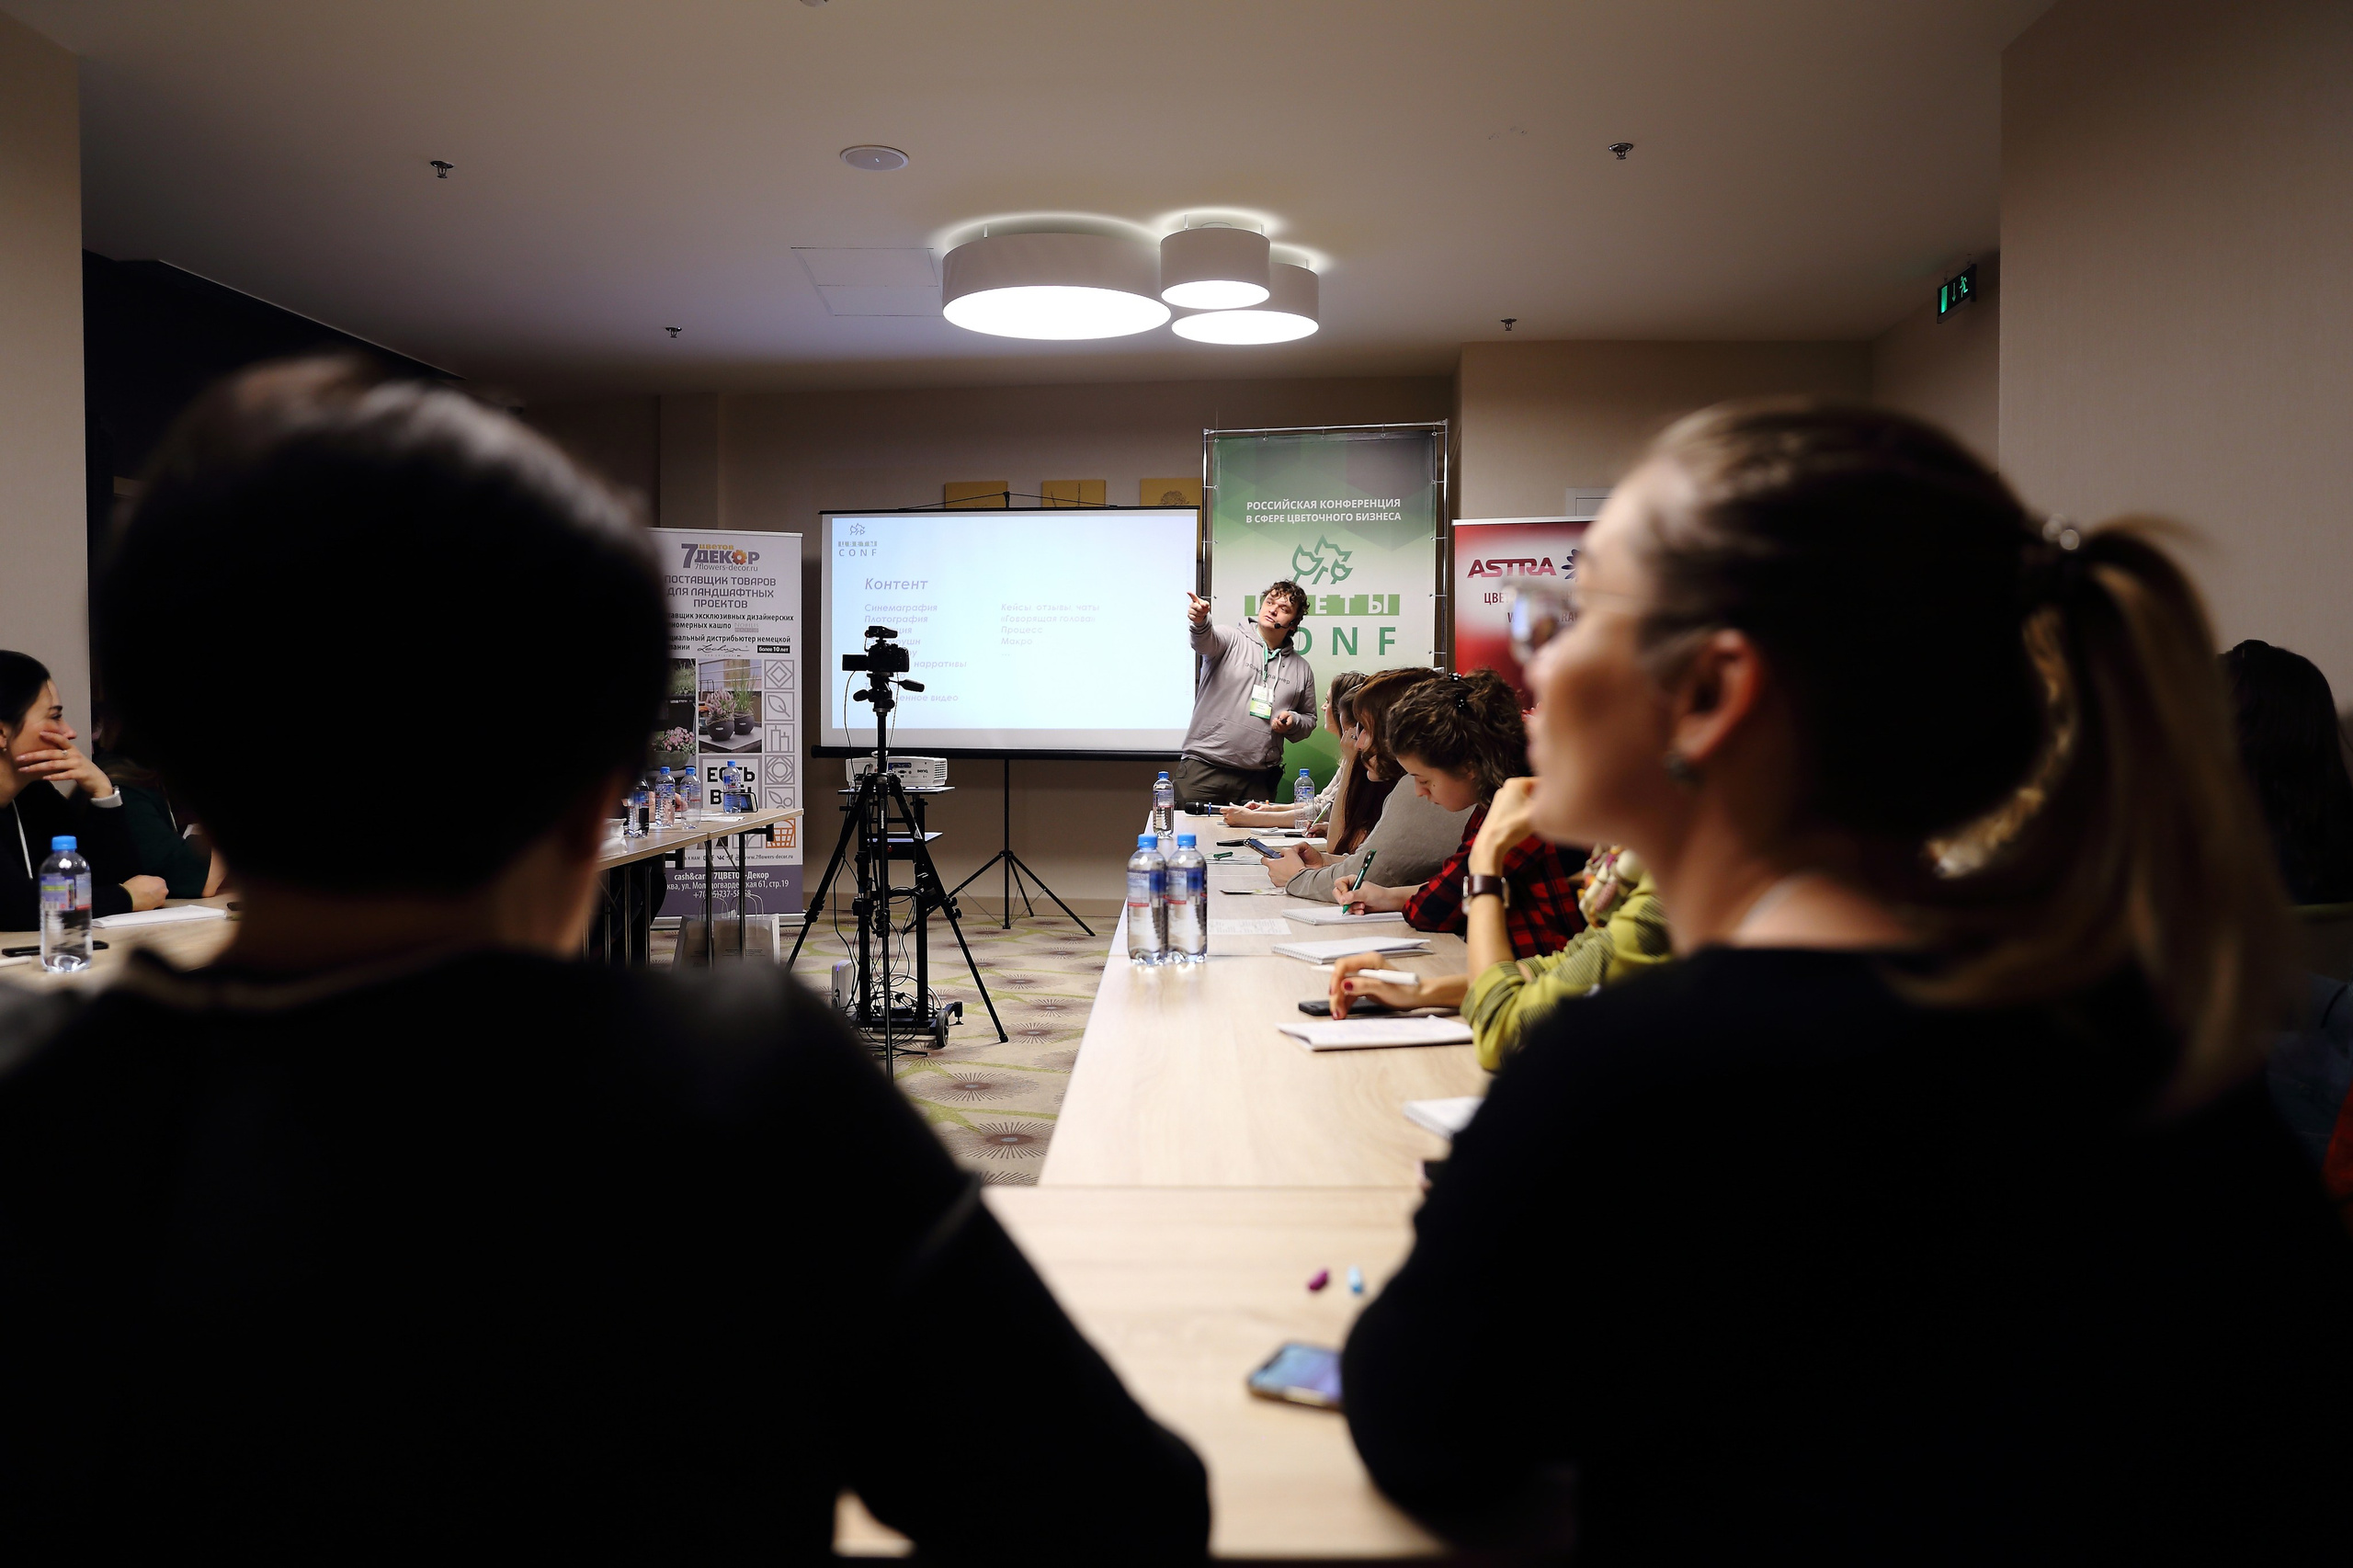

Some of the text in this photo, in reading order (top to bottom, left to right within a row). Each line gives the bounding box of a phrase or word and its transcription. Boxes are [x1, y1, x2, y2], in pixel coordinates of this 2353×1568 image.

[1246, 497, 1401, 510] РОССИЙСКАЯ КОНФЕРЕНЦИЯ
[1246, 513, 1402, 524] В СФЕРЕ ЦВЕТОЧНОГО БИЗНЕСА
[695, 562, 758, 572] 7flowers-decor.ru
[1467, 557, 1557, 578] ASTRA
[731, 576, 777, 586] ТОВАРОВ
[865, 578, 928, 590] Контент
[666, 586, 774, 598] ДЛЯ ЛАНДШАФТНЫХ
[694, 599, 748, 608] ПРОЕКТОВ
[864, 604, 938, 612] Синемаграфия
[746, 613, 794, 621] дизайнерских
[864, 615, 928, 624] Плотография
[1001, 626, 1043, 634] Процесс
[757, 635, 791, 643] немецкой
[1001, 638, 1033, 646] Макро
[914, 661, 967, 669] нарративы
[674, 871, 707, 881] cash&car
[681, 882, 691, 891] ул.
